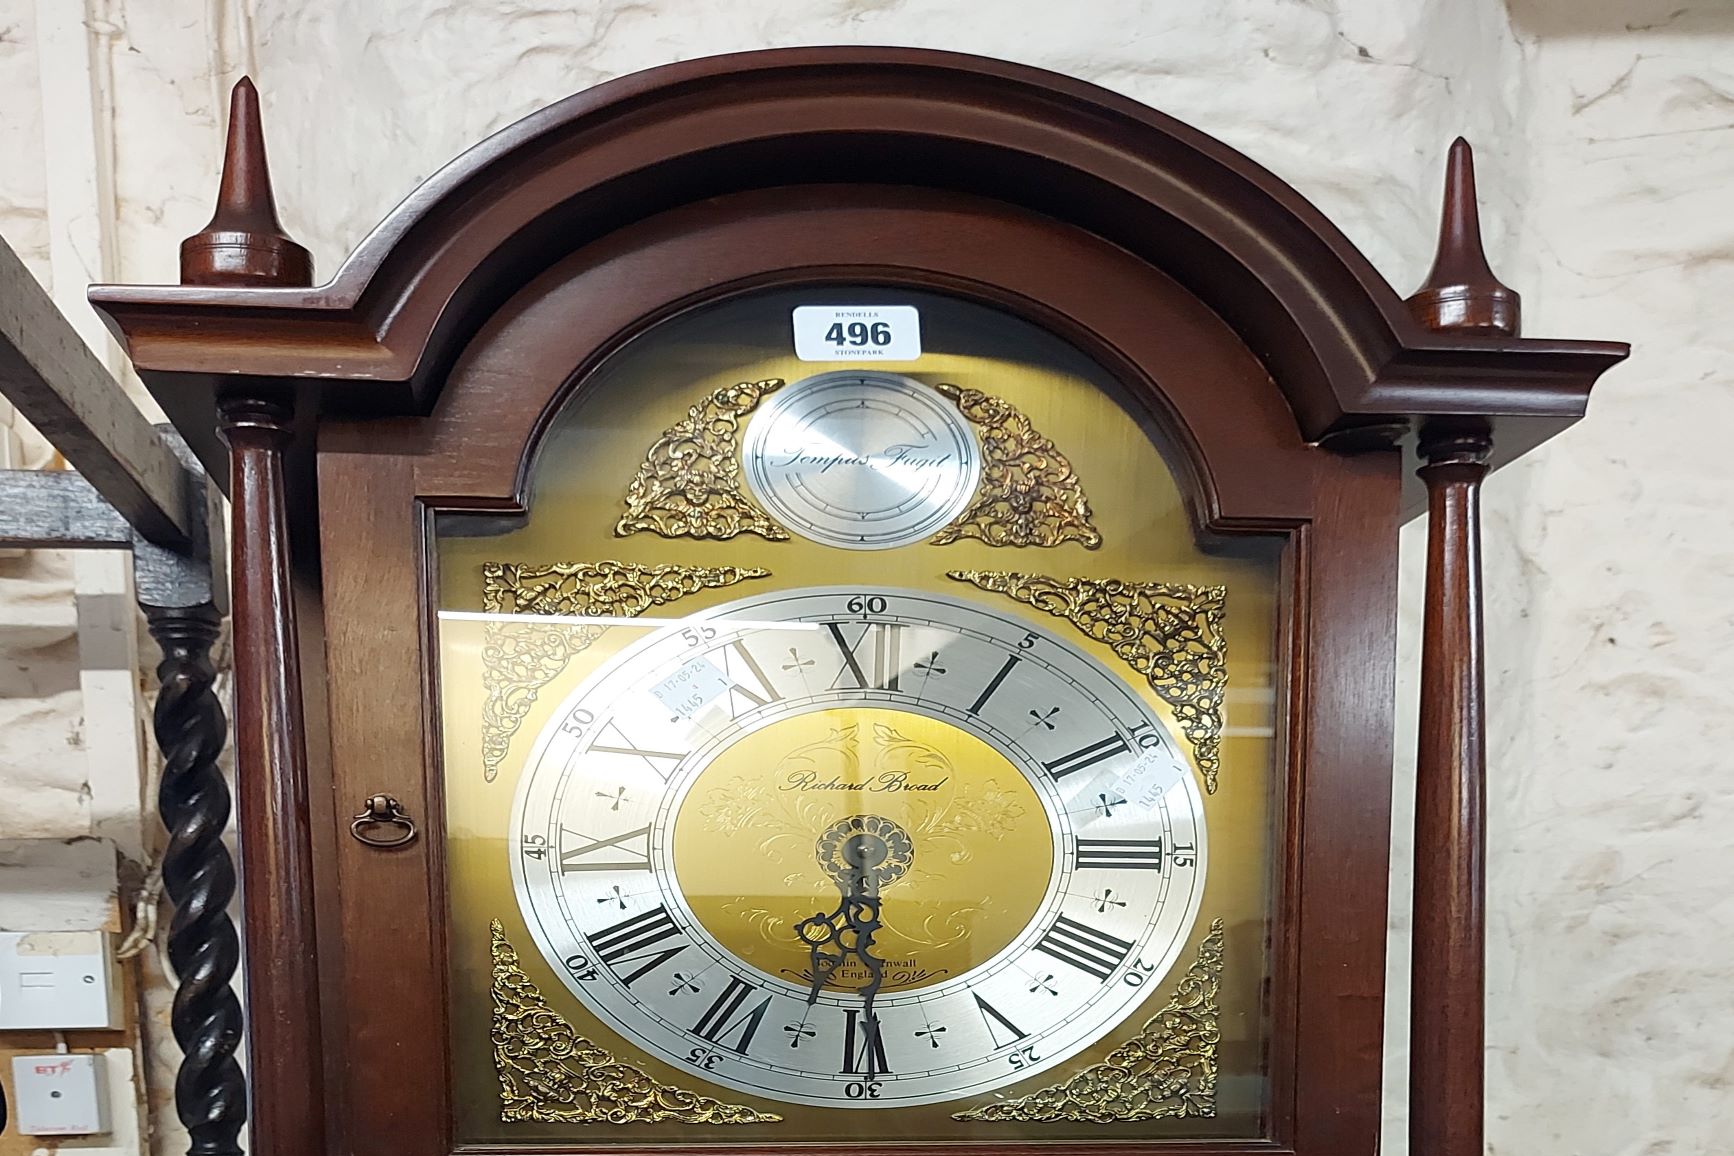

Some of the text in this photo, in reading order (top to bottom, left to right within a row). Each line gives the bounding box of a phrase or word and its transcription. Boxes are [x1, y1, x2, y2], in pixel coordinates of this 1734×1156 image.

[825, 322, 891, 346] 496
[770, 446, 870, 473] Tempus
[846, 596, 888, 614] 60
[681, 626, 716, 647] 55
[1018, 632, 1040, 649] 5
[824, 621, 911, 693] XII
[966, 653, 1022, 716] I
[561, 708, 595, 739] 50
[1127, 719, 1160, 749] 10
[585, 716, 692, 785] X
[1041, 730, 1132, 783] II
[778, 769, 949, 793] Richard Broad
[523, 834, 548, 860] 45
[559, 822, 653, 876] IX
[1075, 835, 1163, 873] III
[1172, 842, 1195, 868] 15
[584, 902, 691, 990] VIII
[1032, 911, 1137, 984] IIII
[565, 954, 600, 982] 40
[841, 969, 889, 980] Englad
[1123, 957, 1155, 988] 20
[686, 974, 774, 1057] VII
[971, 990, 1032, 1051] V
[685, 1047, 725, 1070] 35
[1008, 1045, 1041, 1071] 25
[844, 1082, 883, 1098] 30
